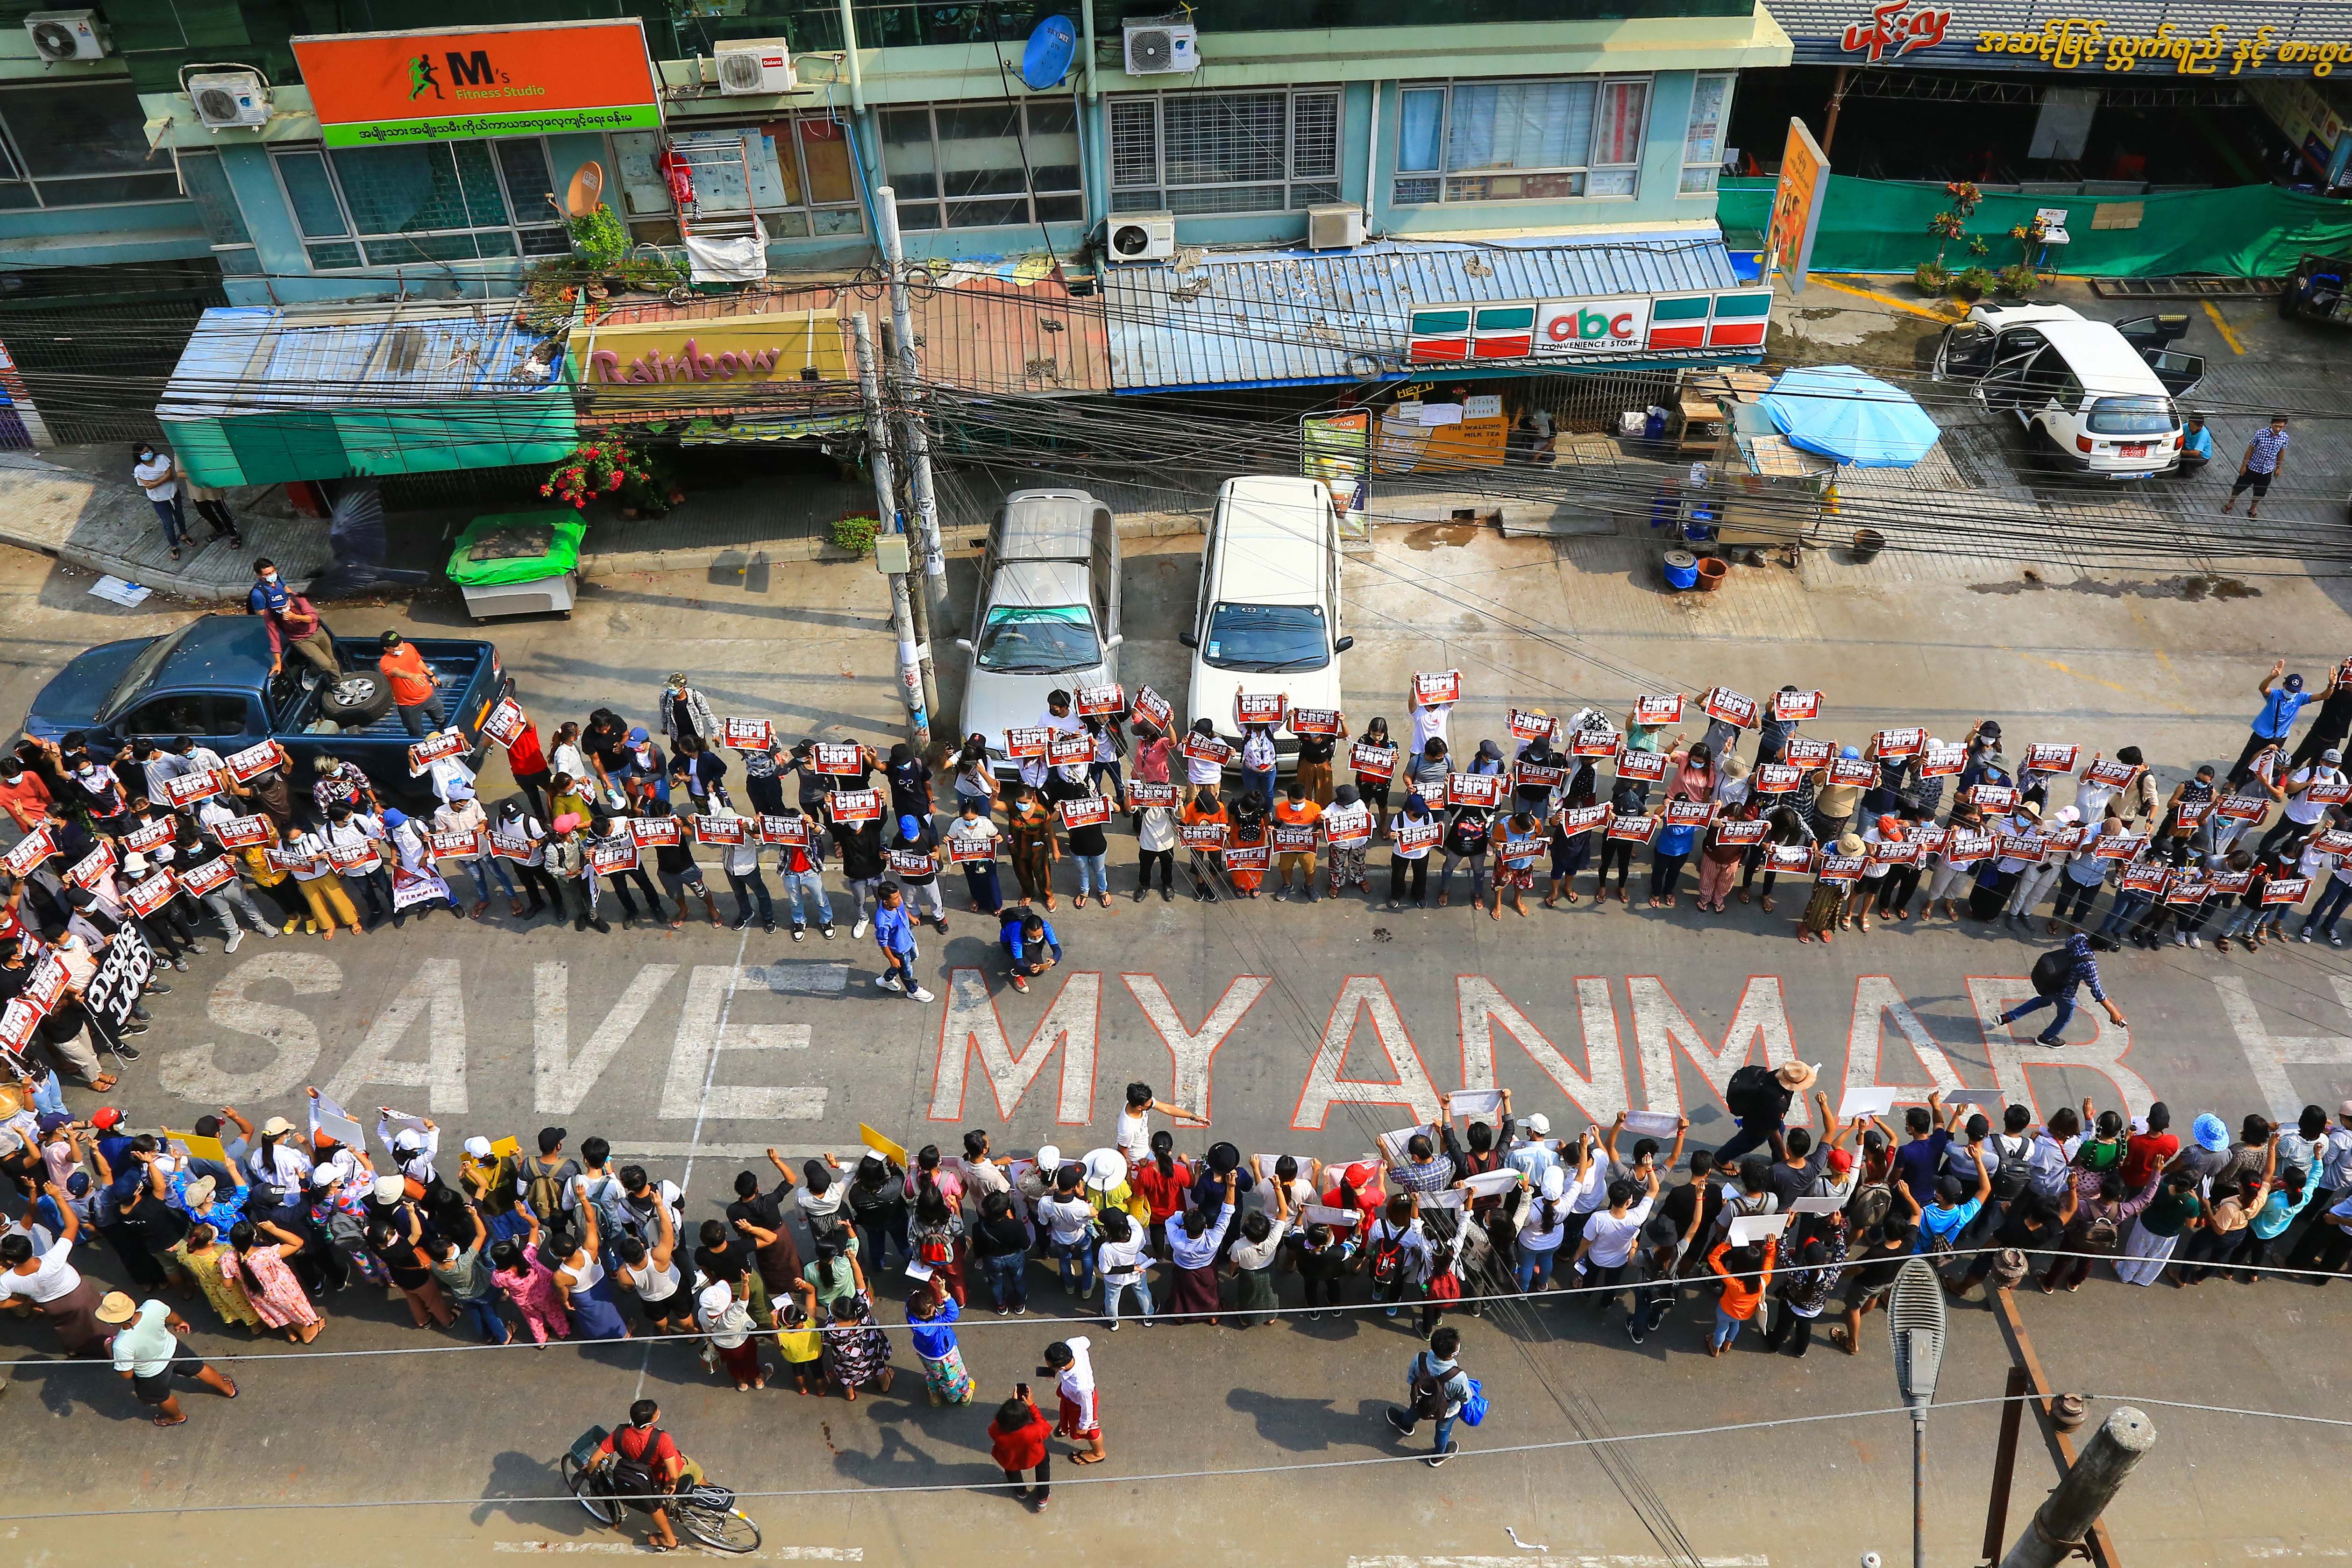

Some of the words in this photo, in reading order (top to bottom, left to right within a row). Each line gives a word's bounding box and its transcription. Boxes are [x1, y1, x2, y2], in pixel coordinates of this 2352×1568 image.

[1047, 28, 1069, 43] SKYNET
[1975, 18, 2108, 69] အဆင့်မြင့်
[2229, 24, 2276, 75] နှင့်
[456, 87, 501, 100] Fitness
[503, 85, 546, 98] Studio
[359, 126, 409, 141] အမျိုးသား
[410, 121, 461, 138] အမျိုးသမီး
[607, 111, 632, 126] ခန်းမ
[1549, 307, 1634, 341] abc
[1542, 339, 1606, 351] CONVENIENCE
[1610, 339, 1638, 348] STORE
[592, 338, 781, 390] Rainbow
[1420, 677, 1455, 692] CRPH
[1714, 693, 1751, 716] CRPH
[1728, 691, 1752, 704] SUPPORT
[1242, 701, 1279, 711] CRPH
[486, 719, 495, 730] WE
[492, 703, 507, 723] SUPPORT
[491, 706, 519, 737] CRPH
[729, 724, 766, 738] CRPH
[1578, 736, 1616, 745] CRPH
[1883, 735, 1919, 747] CRPH
[243, 743, 270, 758] SUPPORT
[820, 752, 858, 762] CRPH
[1355, 750, 1392, 766] CRPH
[1367, 746, 1393, 755] SUPPORT
[1791, 746, 1828, 757] CRPH
[2034, 751, 2072, 762] CRPH
[234, 748, 275, 771] CRPH
[1624, 755, 1662, 770] CRPH
[1927, 754, 1963, 766] CRPH
[179, 771, 209, 781] SUPPORT
[1763, 771, 1799, 781] CRPH
[2093, 766, 2132, 779] CRPH
[171, 776, 213, 796] CRPH
[1453, 780, 1492, 795] CRPH
[1975, 792, 2012, 803] CRPH
[2222, 800, 2262, 810] CRPH
[1330, 816, 1367, 832] CRPH
[1339, 812, 1365, 821] SUPPORT
[130, 825, 169, 846] CRPH
[138, 820, 165, 836] SUPPORT
[636, 822, 675, 836] CRPH
[765, 822, 804, 834] CRPH
[1411, 825, 1438, 834] SUPPORT
[598, 831, 627, 844] RAIDERS
[1402, 829, 1439, 843] CRPH
[7, 849, 16, 859] WE
[16, 831, 40, 853] SUPPORT
[10, 836, 46, 868] CRPH
[953, 843, 991, 851] CRPH
[2126, 869, 2165, 881] CRPH
[130, 887, 140, 896] WE
[138, 872, 165, 891] SUPPORT
[133, 878, 171, 905] CRPH
[33, 983, 42, 994] WE
[38, 960, 56, 985] SUPPORT
[38, 963, 64, 1001] CRPH
[0, 1024, 9, 1036] WE
[5, 1001, 20, 1029] SUPPORT
[6, 1004, 32, 1043] CRPH
[159, 951, 849, 1121] SAVE
[927, 965, 2160, 1128] MYANMAR
